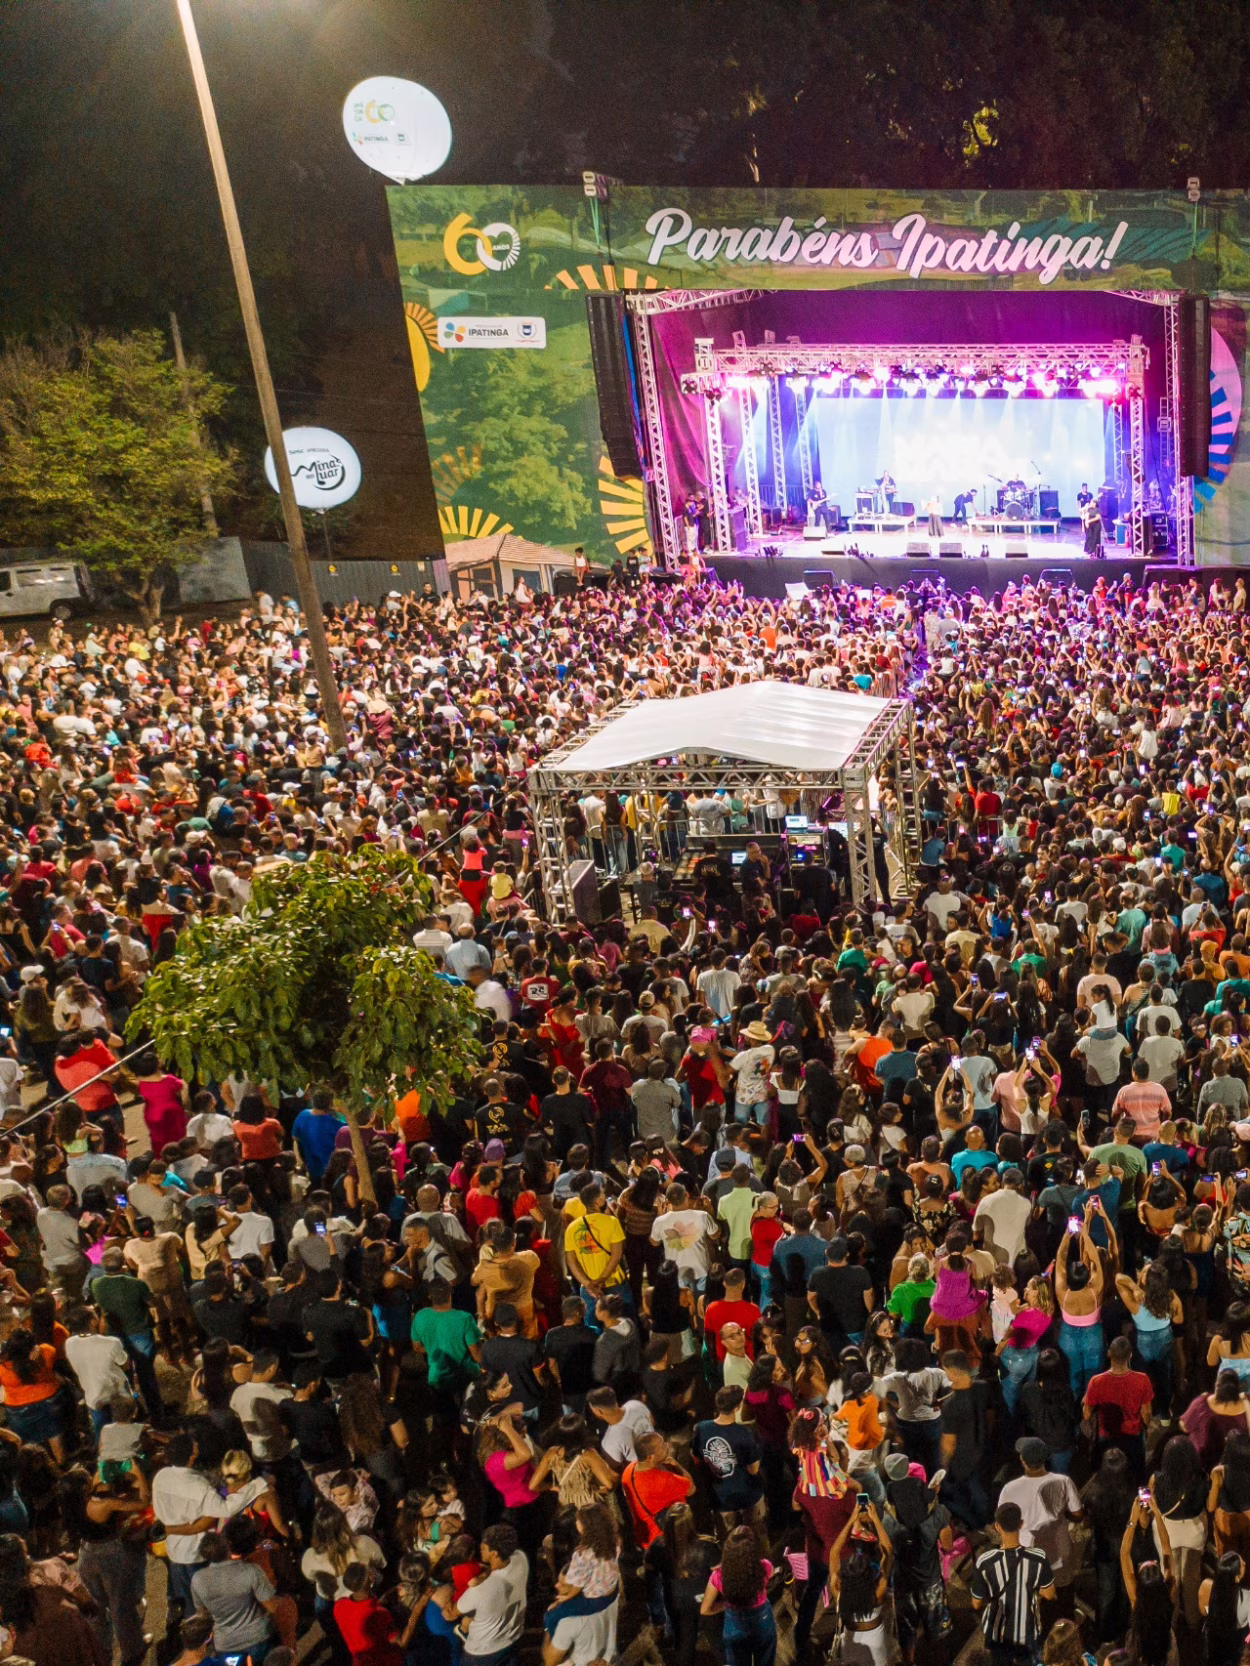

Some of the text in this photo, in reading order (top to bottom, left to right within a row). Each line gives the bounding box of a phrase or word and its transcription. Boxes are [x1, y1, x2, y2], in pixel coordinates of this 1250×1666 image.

[645, 207, 1129, 285] Parabéns Ipatinga!
[468, 328, 509, 337] IPATINGA
